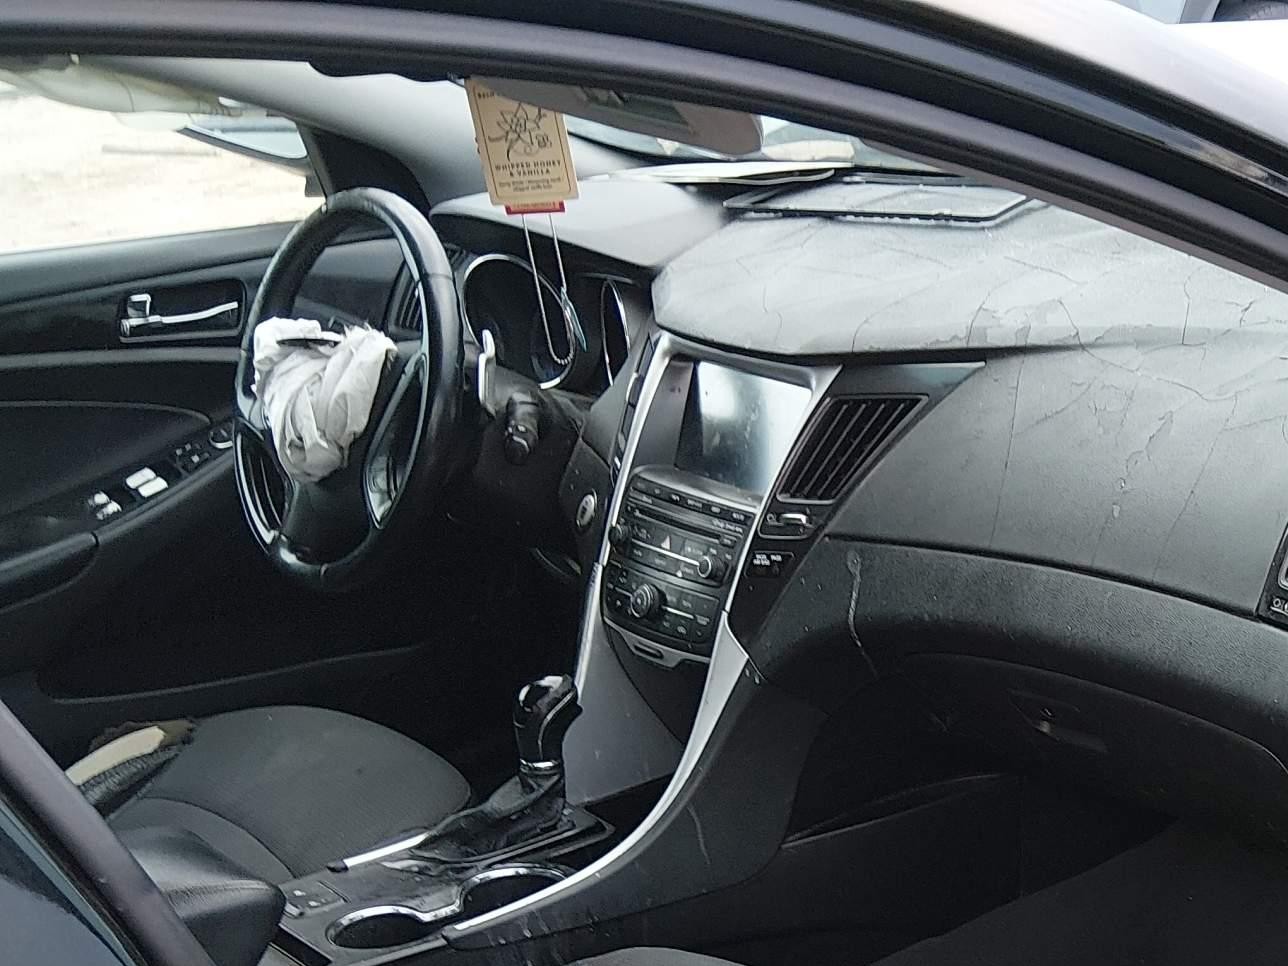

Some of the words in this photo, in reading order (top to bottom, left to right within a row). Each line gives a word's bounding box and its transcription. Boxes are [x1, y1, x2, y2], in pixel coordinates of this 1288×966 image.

[495, 161, 530, 171] WHIPPED
[533, 159, 561, 168] HONEY
[516, 168, 550, 176] VANILLA
